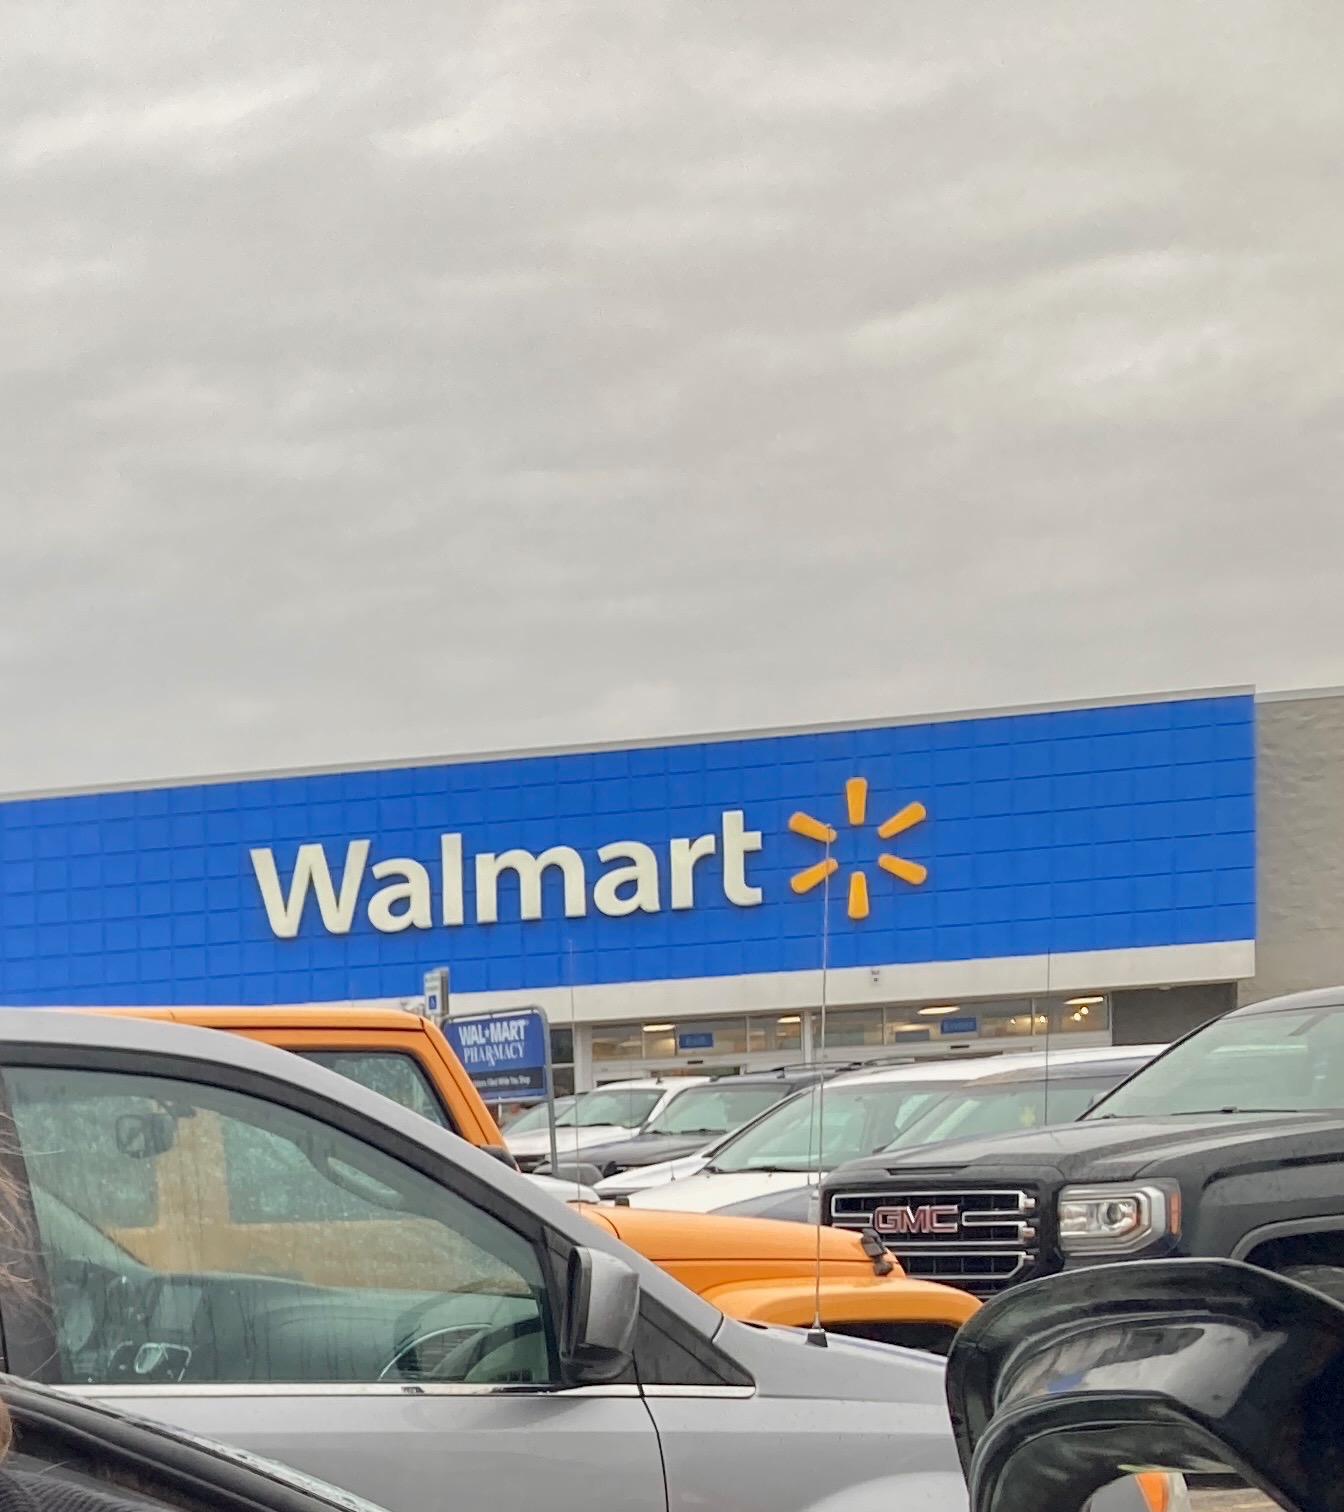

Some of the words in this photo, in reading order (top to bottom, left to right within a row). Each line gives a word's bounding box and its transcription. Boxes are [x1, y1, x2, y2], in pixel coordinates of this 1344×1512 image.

[250, 810, 762, 938] Walmart
[463, 1042, 524, 1066] PHARMACY
[875, 1204, 959, 1233] GMC
